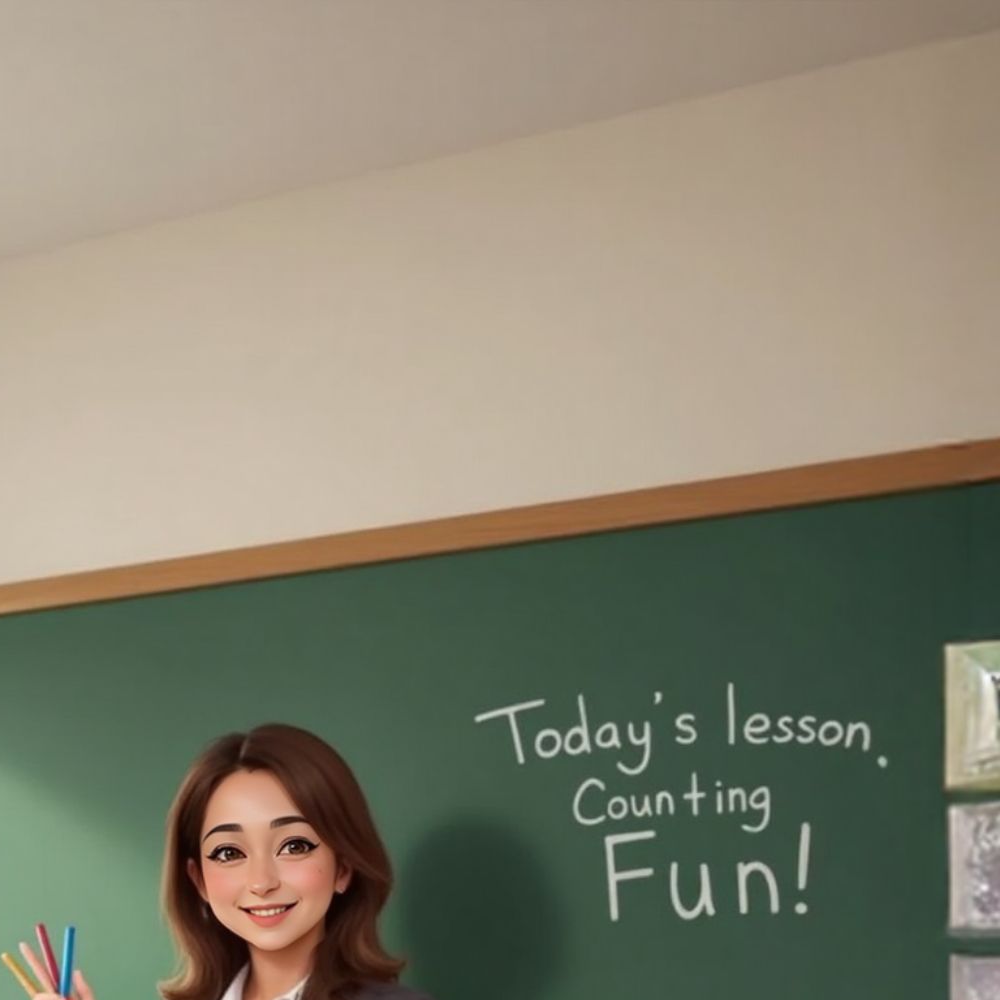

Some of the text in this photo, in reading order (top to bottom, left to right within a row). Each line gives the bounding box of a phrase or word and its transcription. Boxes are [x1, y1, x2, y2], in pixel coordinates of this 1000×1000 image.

[474, 691, 698, 776] Today's
[572, 772, 772, 833] Counting
[604, 822, 812, 922] Fun!
